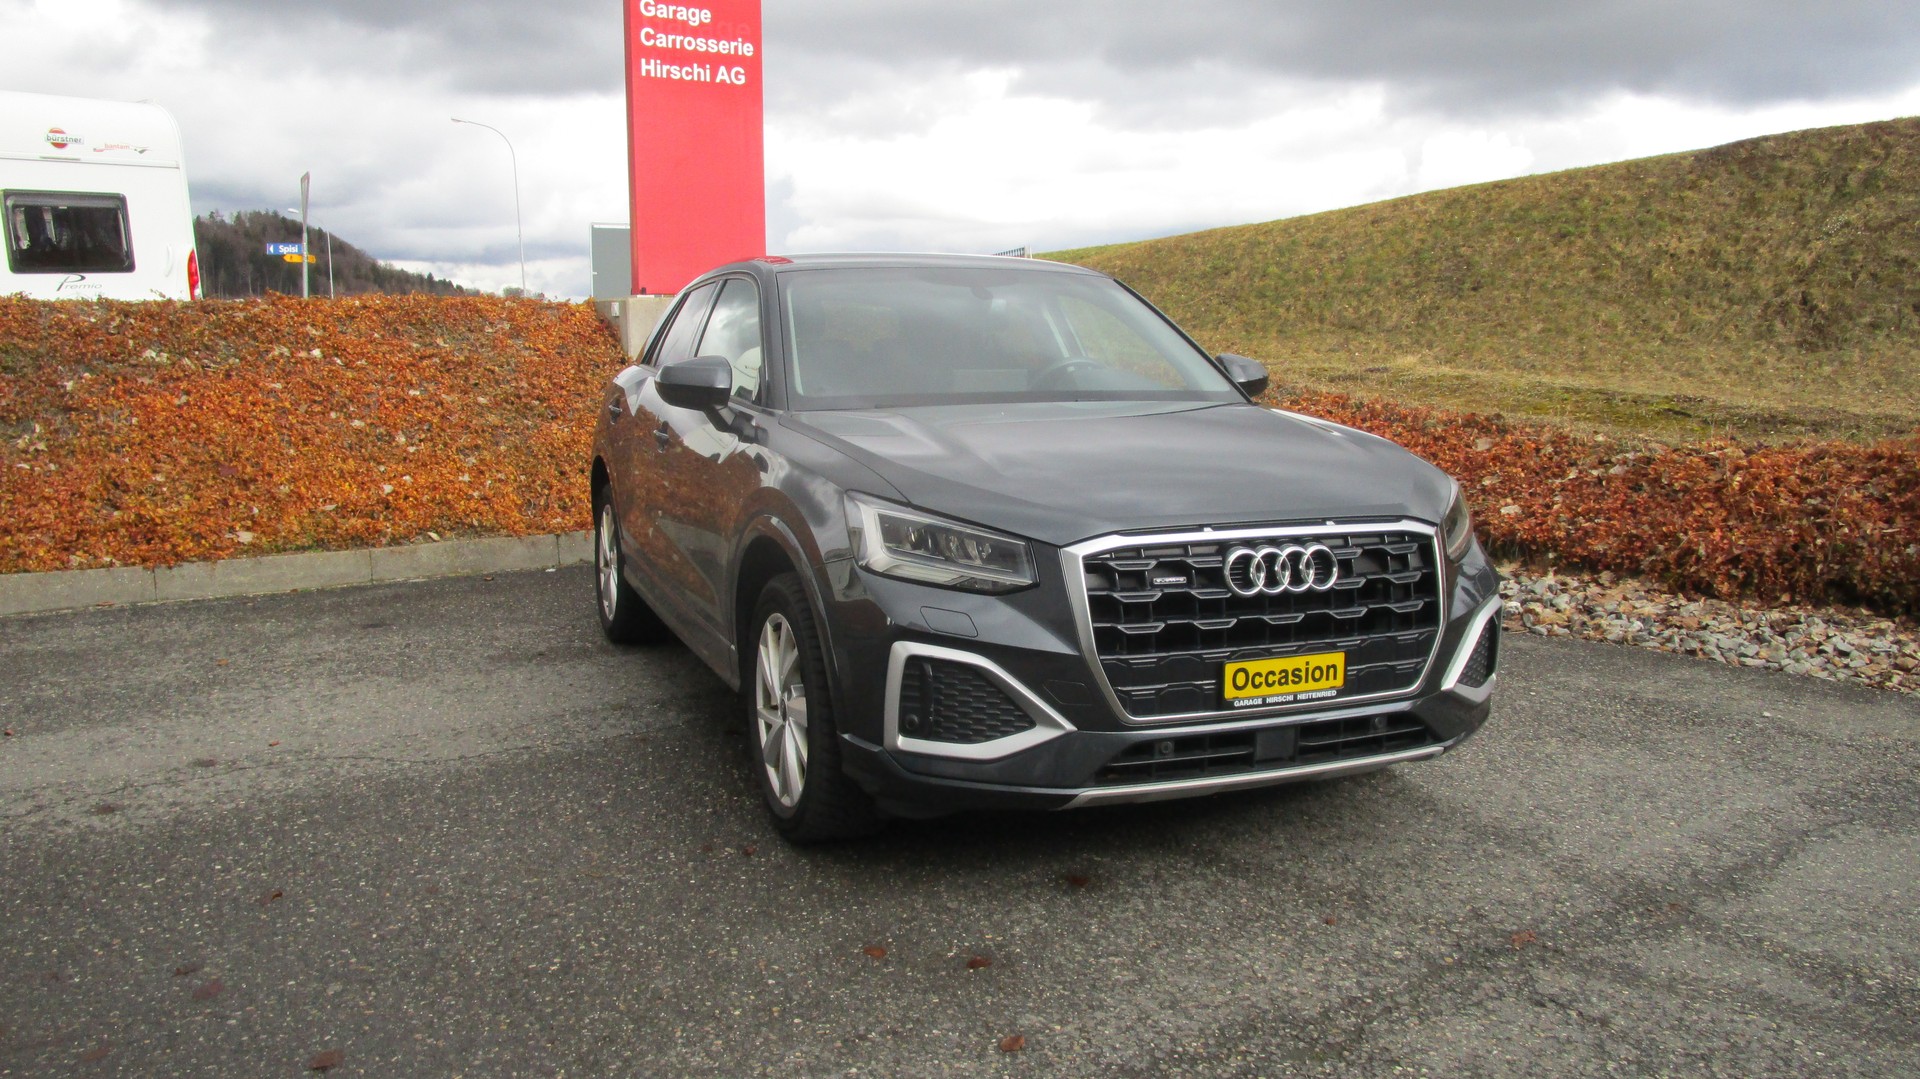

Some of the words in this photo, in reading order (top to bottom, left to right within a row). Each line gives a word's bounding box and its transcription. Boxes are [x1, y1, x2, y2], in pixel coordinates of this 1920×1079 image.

[640, 0, 711, 26] Garage
[640, 27, 754, 57] Carrosserie
[641, 58, 710, 82] Hirschi
[715, 65, 746, 85] AG
[46, 134, 82, 143] bürstner
[278, 244, 298, 254] Spisi
[56, 273, 102, 291] Premio
[1232, 661, 1338, 691] Occasion
[1234, 698, 1262, 707] GARAGE
[1266, 695, 1294, 704] HIRSCHI
[1297, 690, 1338, 700] HEITENRIED
